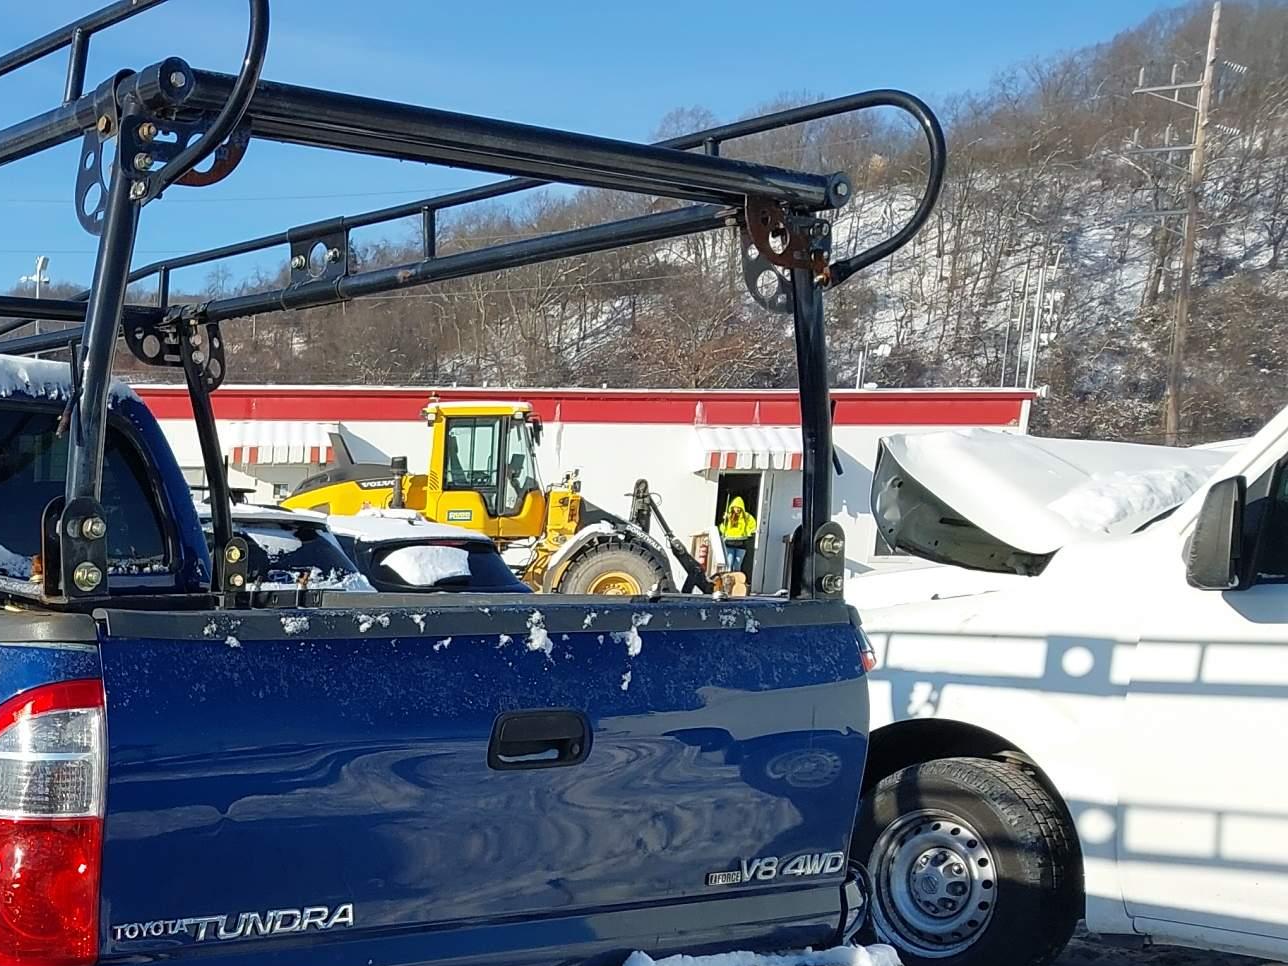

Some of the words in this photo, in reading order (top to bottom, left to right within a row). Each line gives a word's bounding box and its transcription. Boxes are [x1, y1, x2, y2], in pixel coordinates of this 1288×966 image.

[740, 856, 778, 882] V8
[782, 851, 845, 876] 4WD
[113, 918, 188, 941] TOYOTA
[183, 903, 354, 943] TUNDRA
